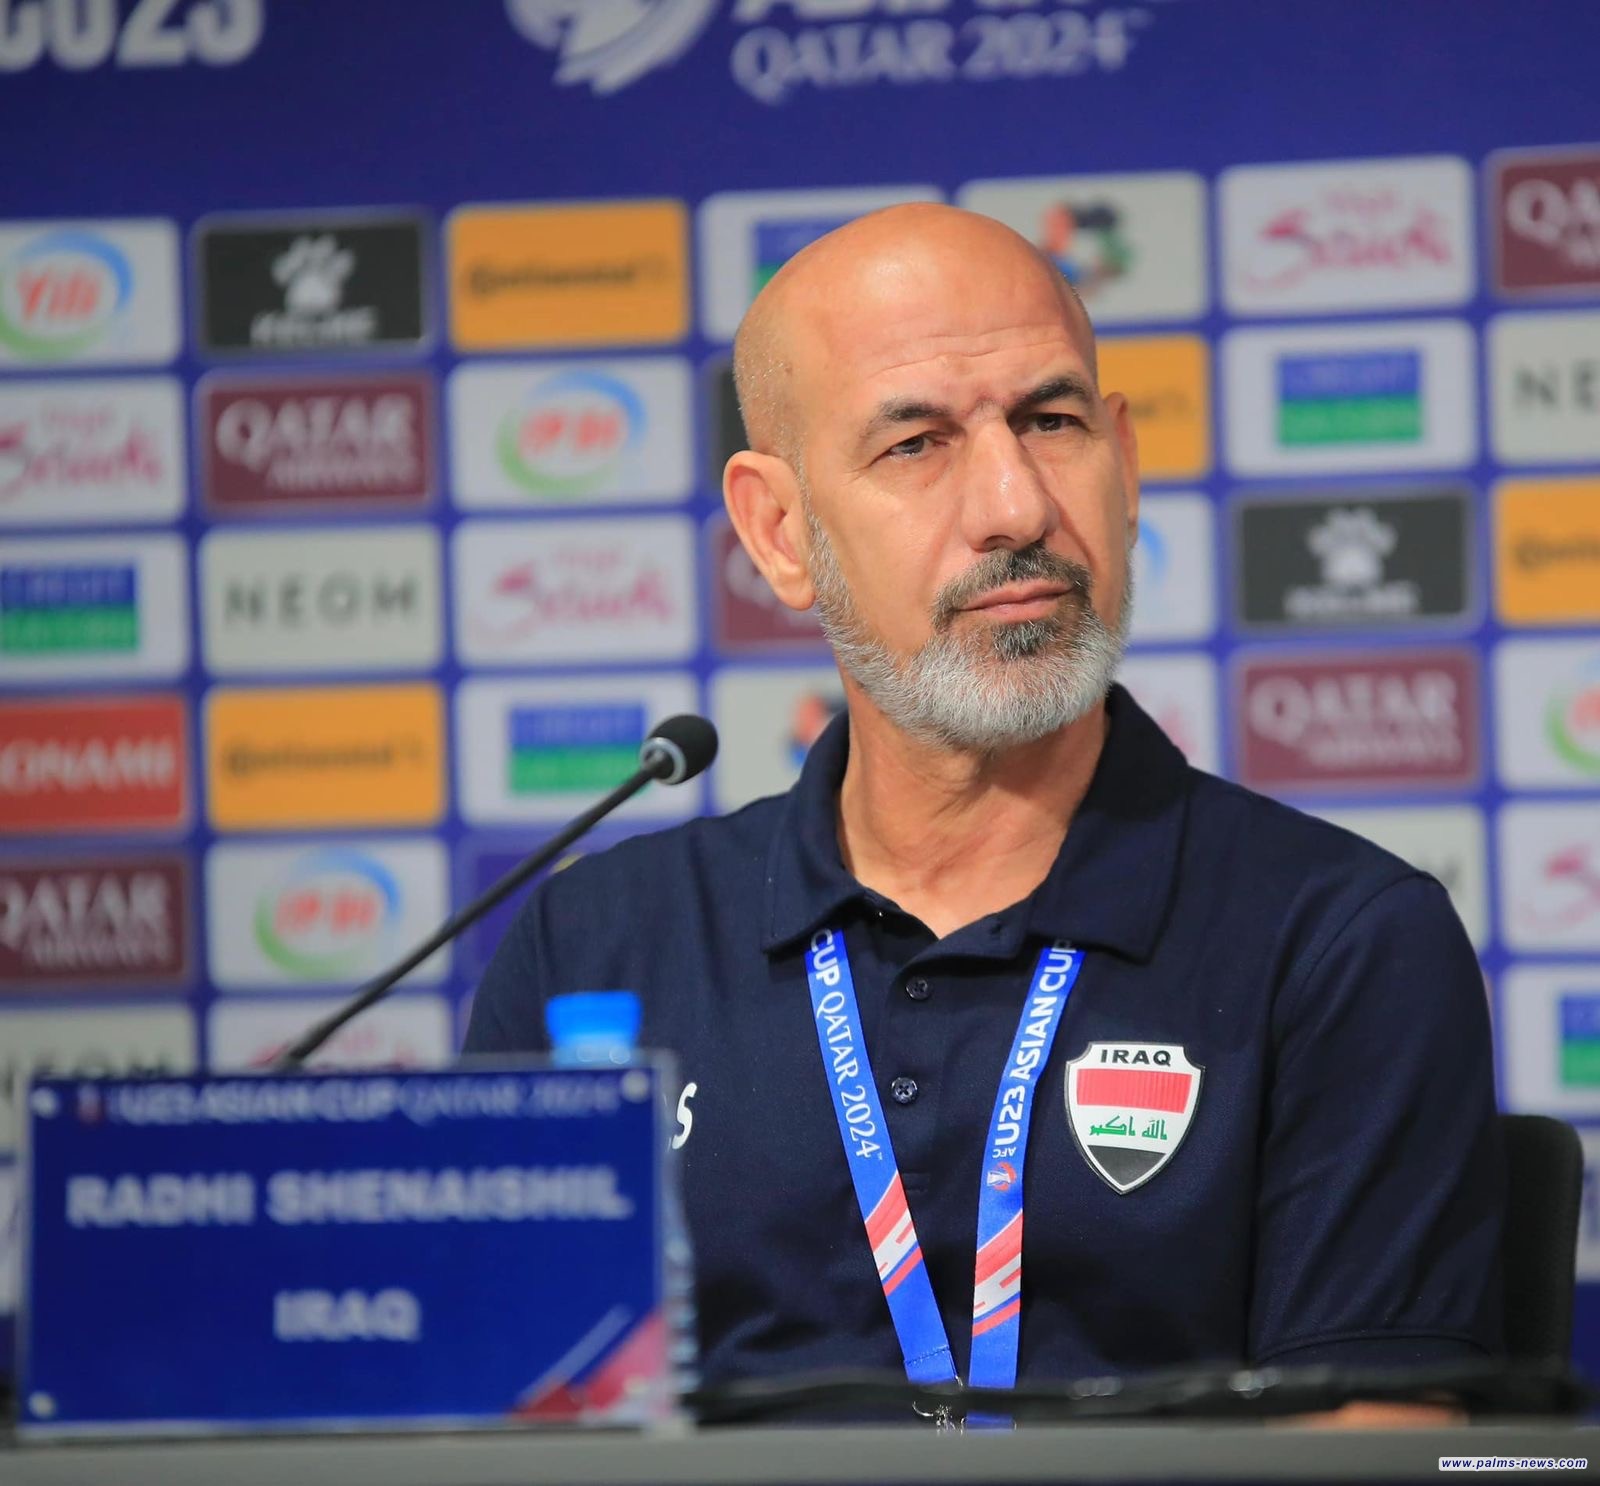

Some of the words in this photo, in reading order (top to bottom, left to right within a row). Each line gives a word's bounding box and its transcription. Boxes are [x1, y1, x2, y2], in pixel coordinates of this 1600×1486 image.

[731, 20, 955, 104] QATAR
[215, 394, 416, 472] QATAR
[223, 568, 420, 622] NEOM
[810, 928, 841, 987] CUP
[816, 991, 859, 1086] QATAR
[1010, 997, 1057, 1080] ASIAN
[1100, 1049, 1171, 1067] IRAQ
[995, 1084, 1026, 1146] U23
[66, 1172, 256, 1228] RADHI
[265, 1166, 635, 1224] SHENAISHIL
[272, 1286, 422, 1342] IRAQ
